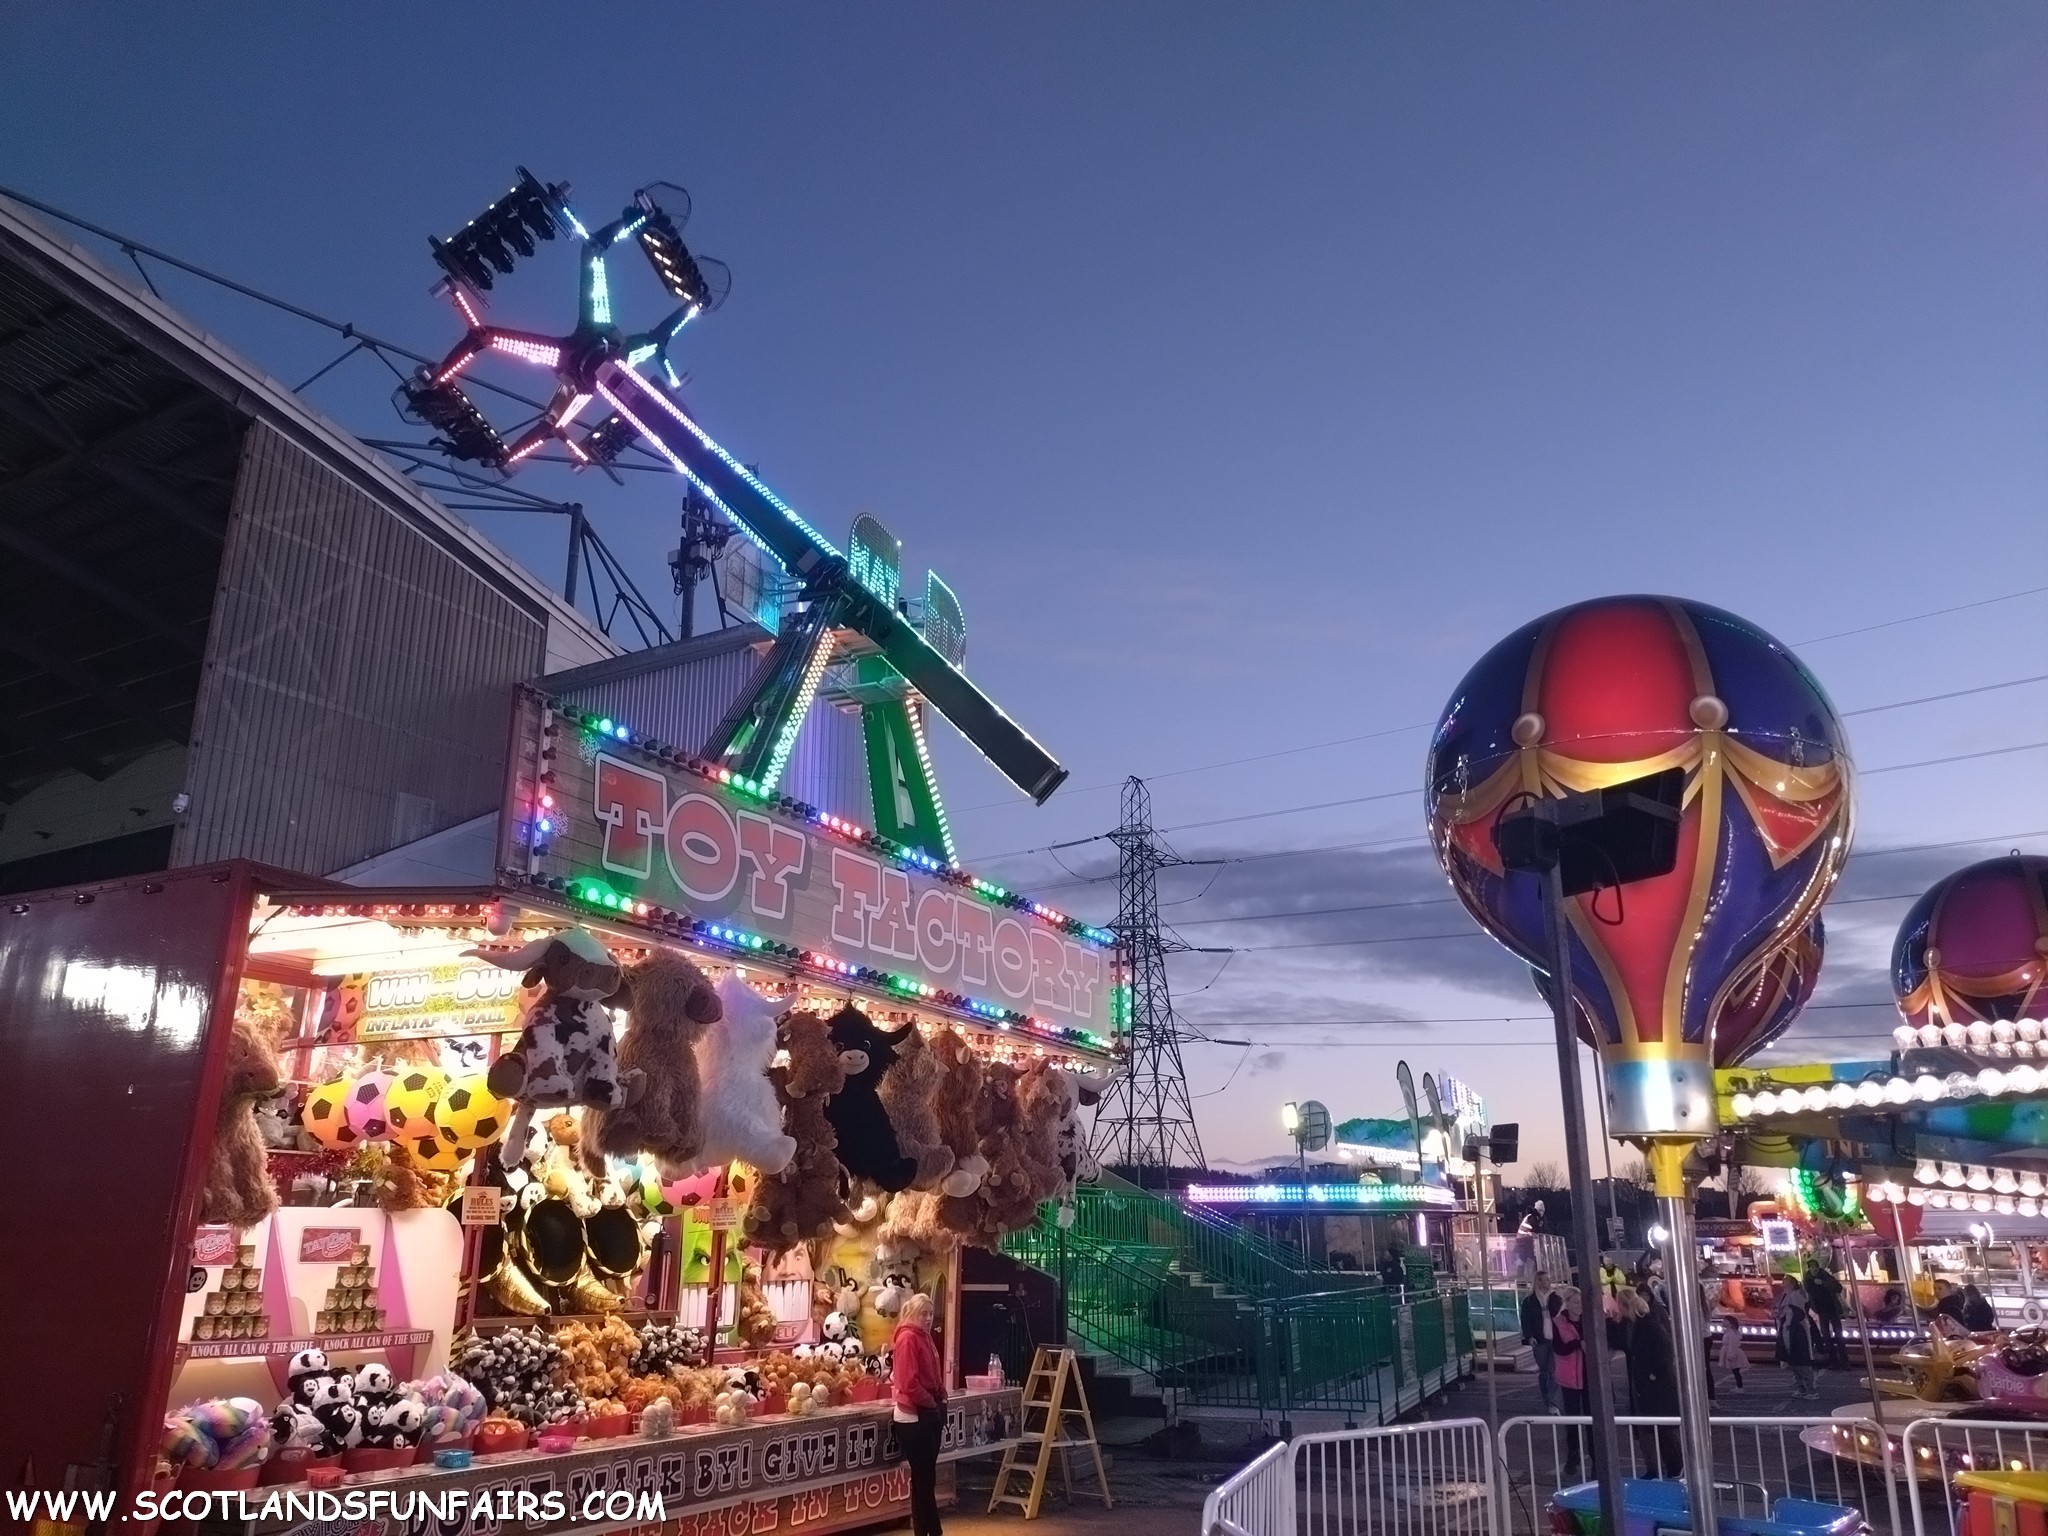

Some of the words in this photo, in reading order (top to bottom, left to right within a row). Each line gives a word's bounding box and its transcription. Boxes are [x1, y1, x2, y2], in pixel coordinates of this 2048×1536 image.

[594, 751, 806, 920] TOY
[830, 846, 1102, 1019] FACTORY
[366, 972, 431, 1011] WIN
[365, 1011, 461, 1033] INFLATABE
[464, 1007, 506, 1025] BALL
[190, 1344, 221, 1358] KNOCK
[222, 1343, 239, 1356] ALL
[240, 1343, 256, 1355] CAN
[258, 1343, 271, 1354] OF
[272, 1342, 289, 1354] THE
[323, 1339, 350, 1351] KNOCK
[350, 1337, 365, 1349] ALL
[366, 1336, 381, 1347] CAN
[382, 1335, 393, 1346] OF
[394, 1334, 409, 1345] THE
[409, 1332, 431, 1344] SHELF
[1988, 1370, 2026, 1394] Barbie
[567, 1450, 685, 1518] WALK
[694, 1439, 753, 1497] BY!
[761, 1427, 840, 1485] GIVE
[845, 1421, 879, 1471] IT
[883, 1406, 967, 1459] AY!
[790, 1486, 834, 1530] IN
[843, 1466, 914, 1512] TOW
